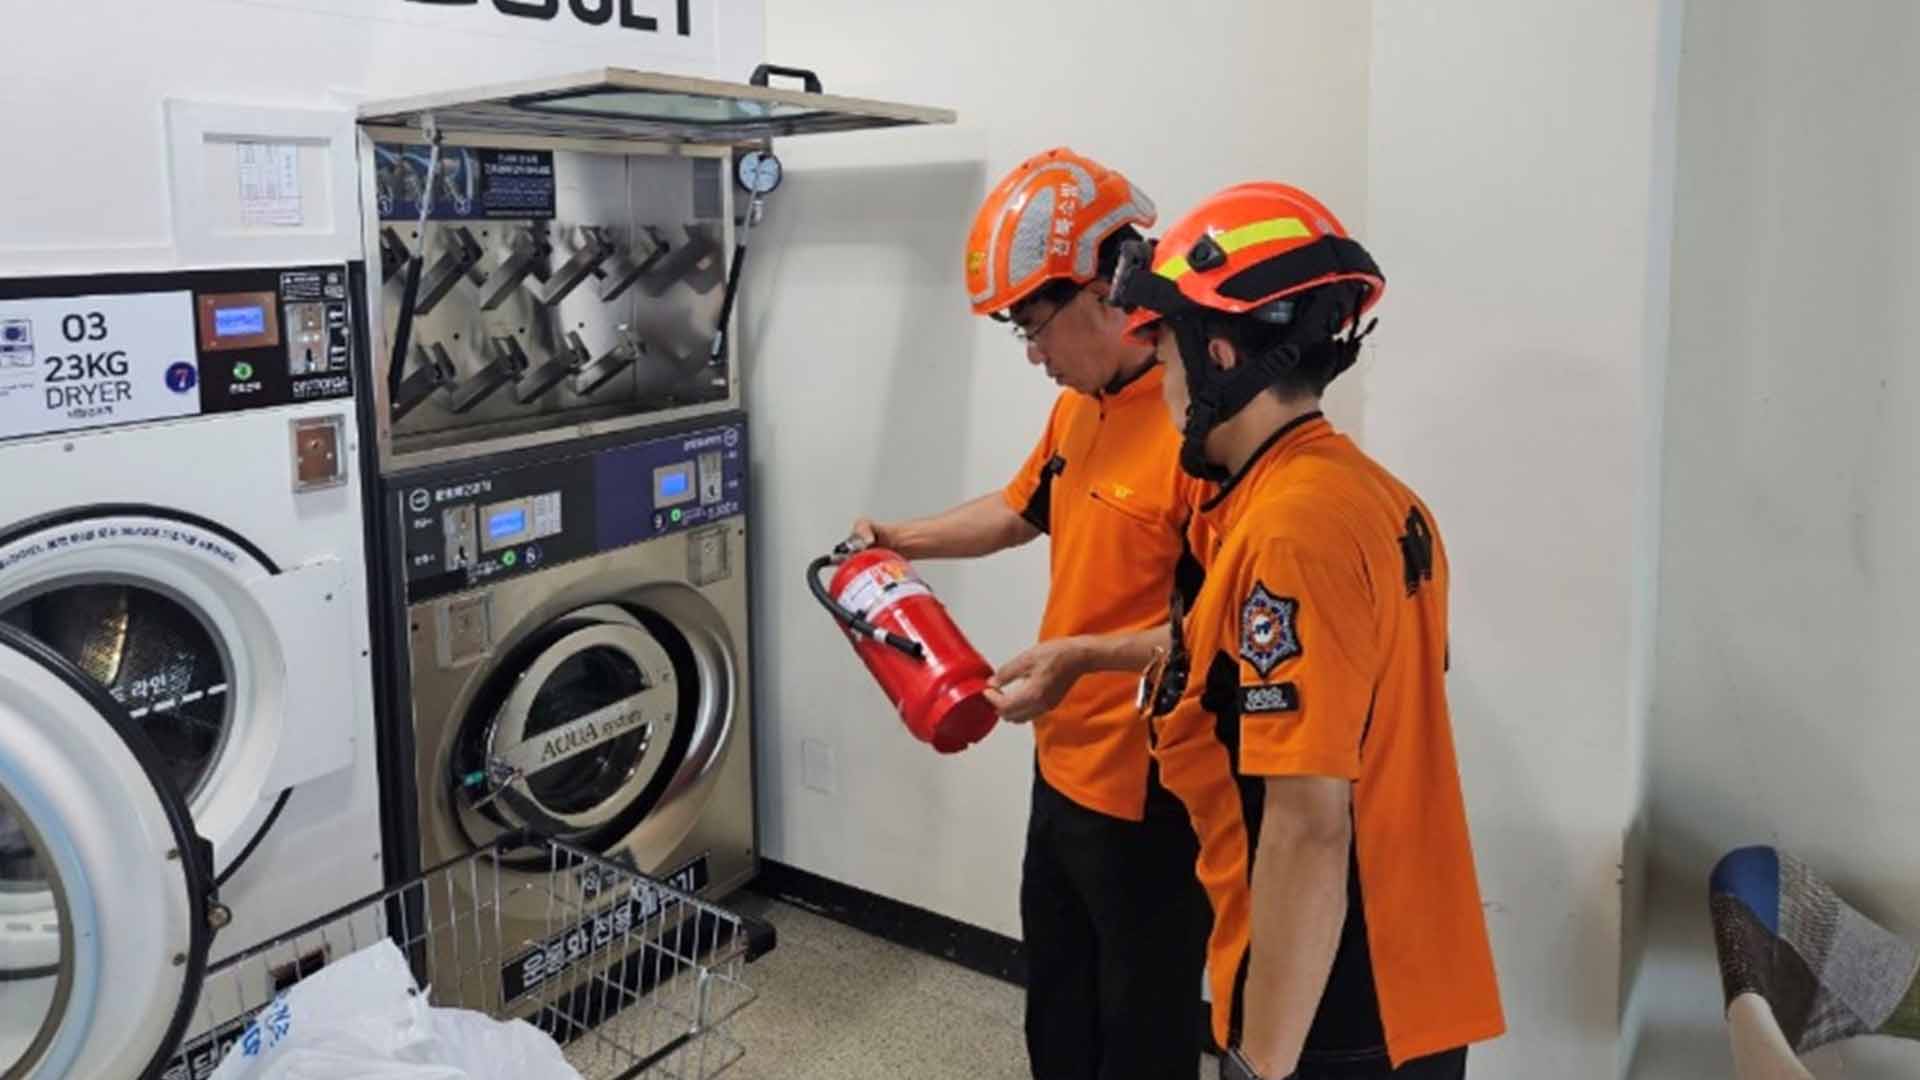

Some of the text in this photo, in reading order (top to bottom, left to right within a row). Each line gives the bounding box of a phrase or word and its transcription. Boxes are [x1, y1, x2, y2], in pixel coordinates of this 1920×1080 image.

[62, 311, 108, 343] 03
[44, 350, 129, 383] 23KG
[46, 380, 132, 410] DRYER
[541, 721, 599, 761] AQUA
